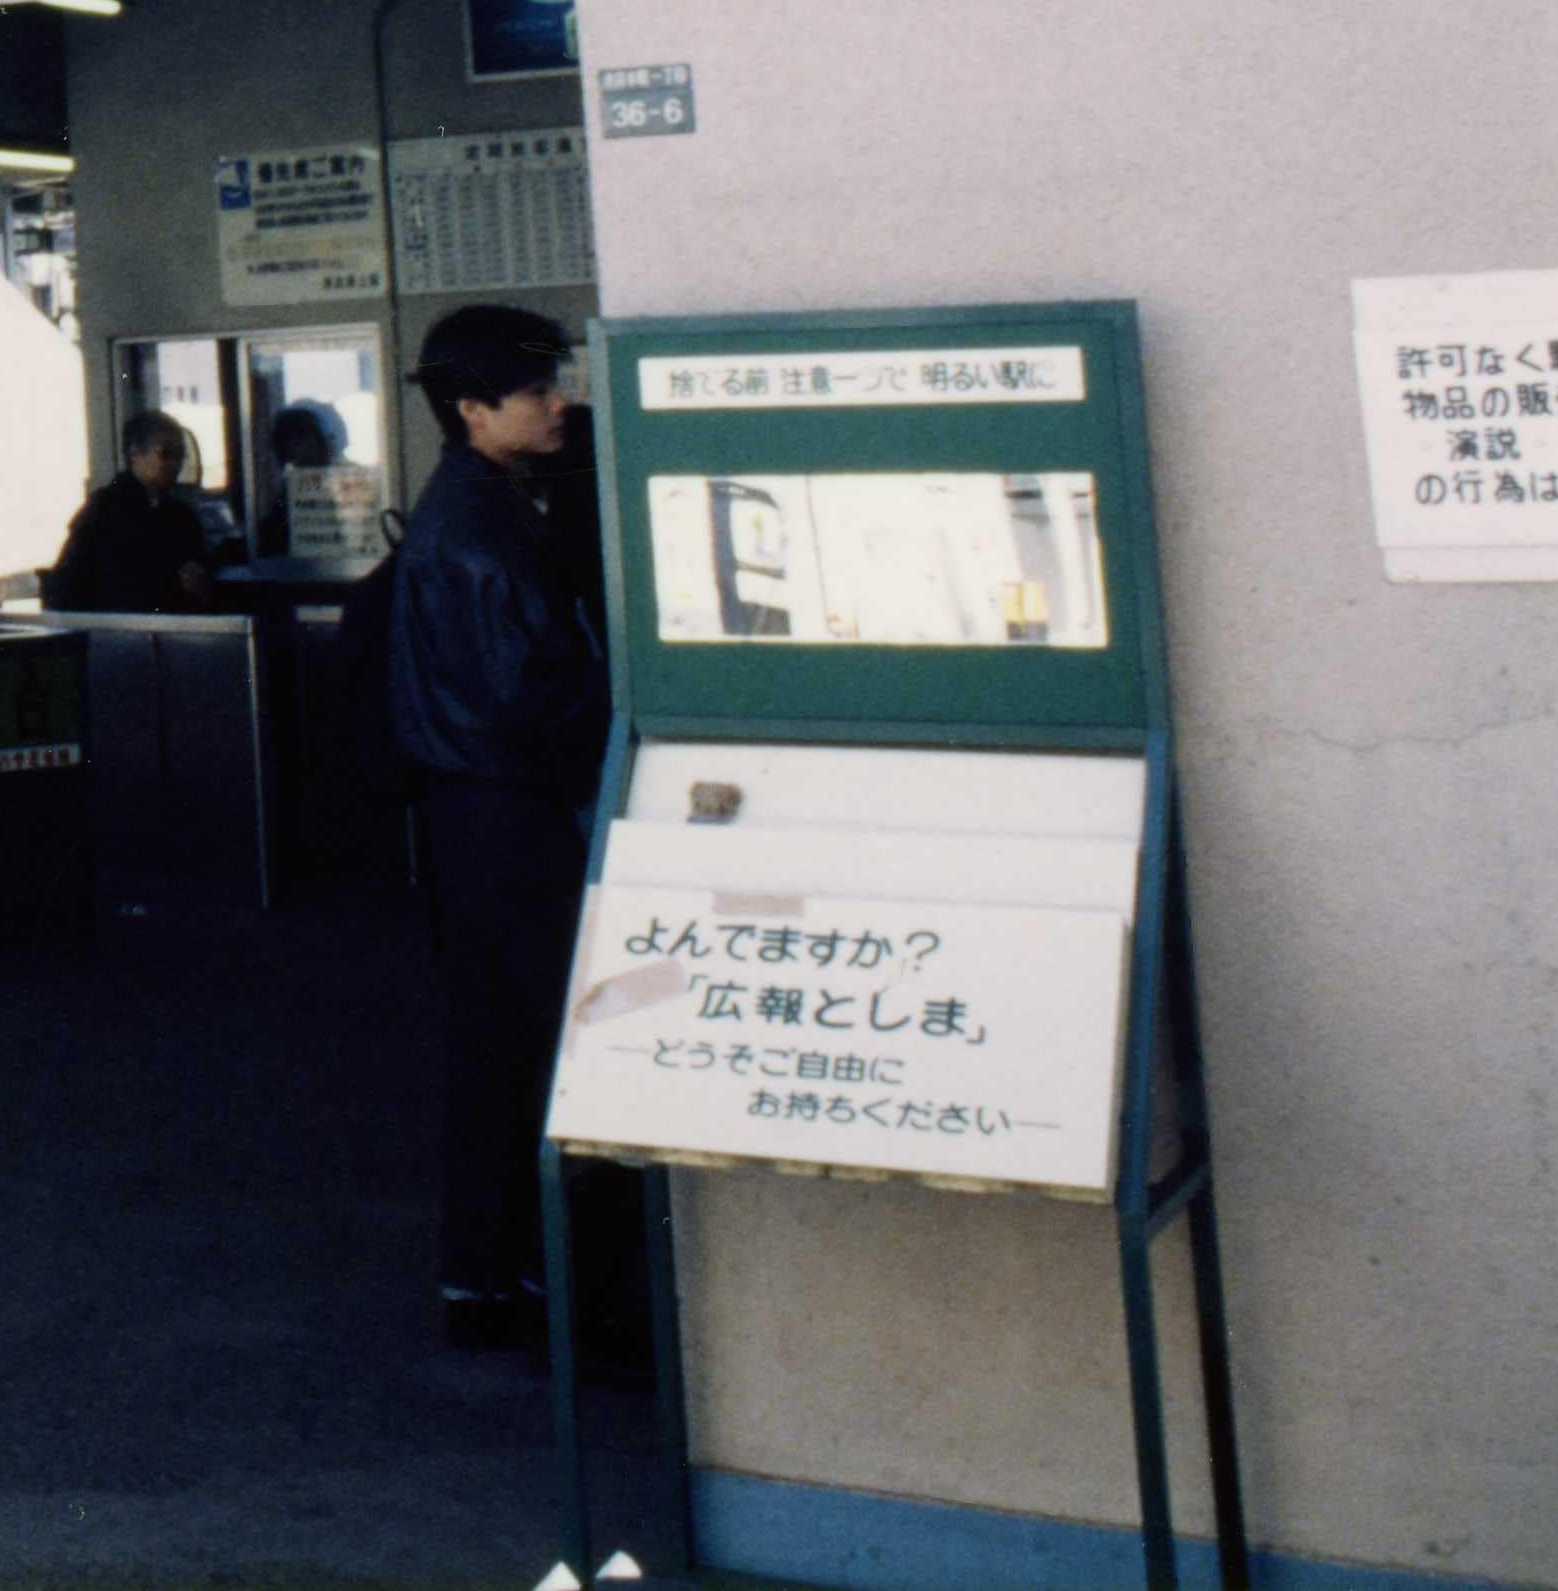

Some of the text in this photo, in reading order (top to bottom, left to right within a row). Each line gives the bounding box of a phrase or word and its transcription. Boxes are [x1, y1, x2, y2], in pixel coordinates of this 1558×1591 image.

[612, 97, 684, 128] 36-6
[1402, 383, 1558, 420] 物品の販
[1446, 428, 1522, 461] 演説
[1415, 471, 1558, 505] の行為は
[625, 917, 941, 972] よんでますか？
[687, 973, 986, 1046] 「広報としま」
